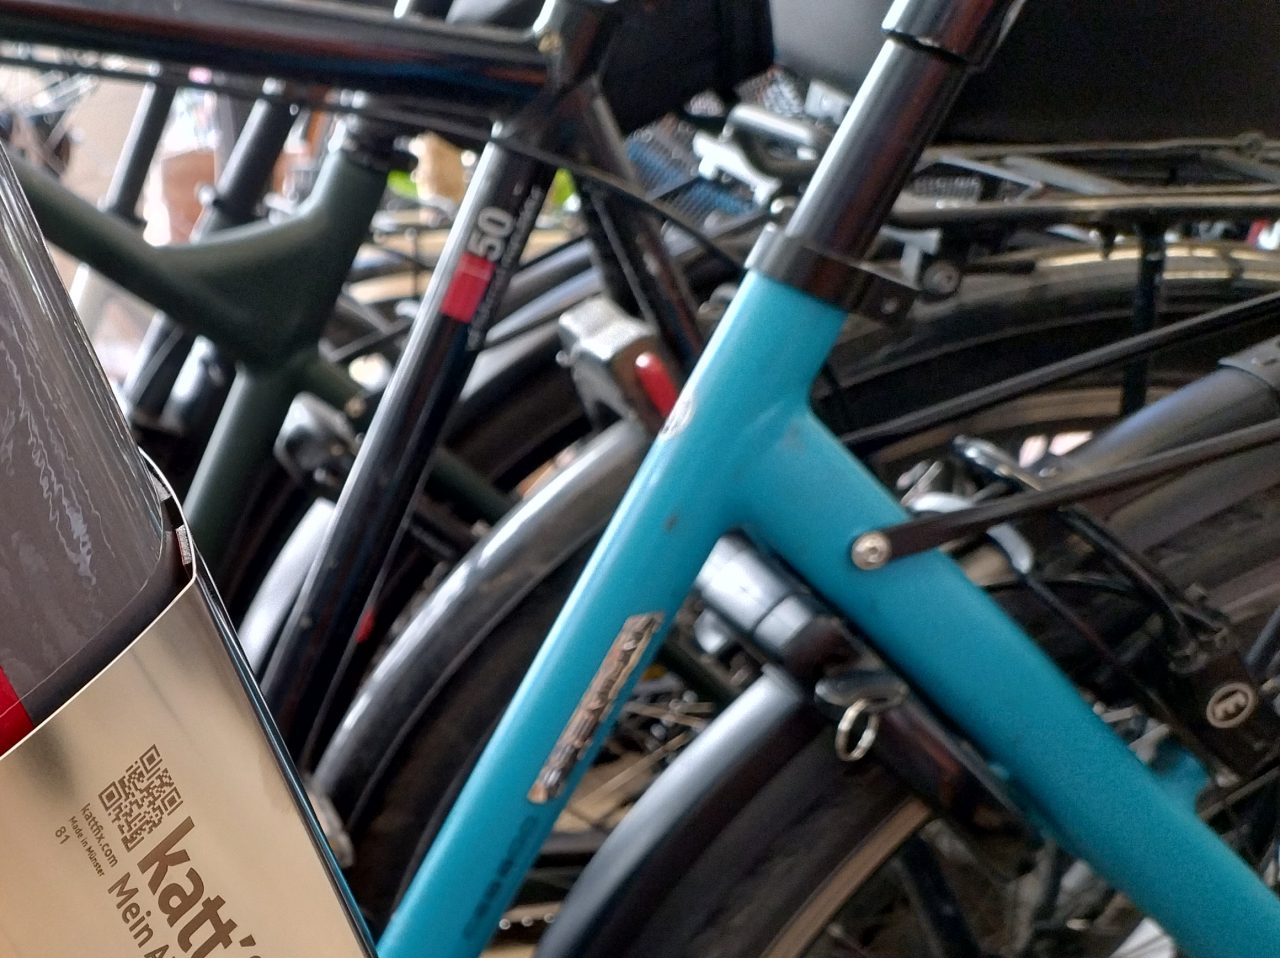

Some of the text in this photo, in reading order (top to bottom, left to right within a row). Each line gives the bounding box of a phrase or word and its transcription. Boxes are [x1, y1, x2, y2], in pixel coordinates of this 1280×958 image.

[55, 825, 71, 845] 81
[68, 815, 106, 877] Made in Münster
[80, 802, 119, 868] kattfix.com
[107, 871, 155, 949] Mein
